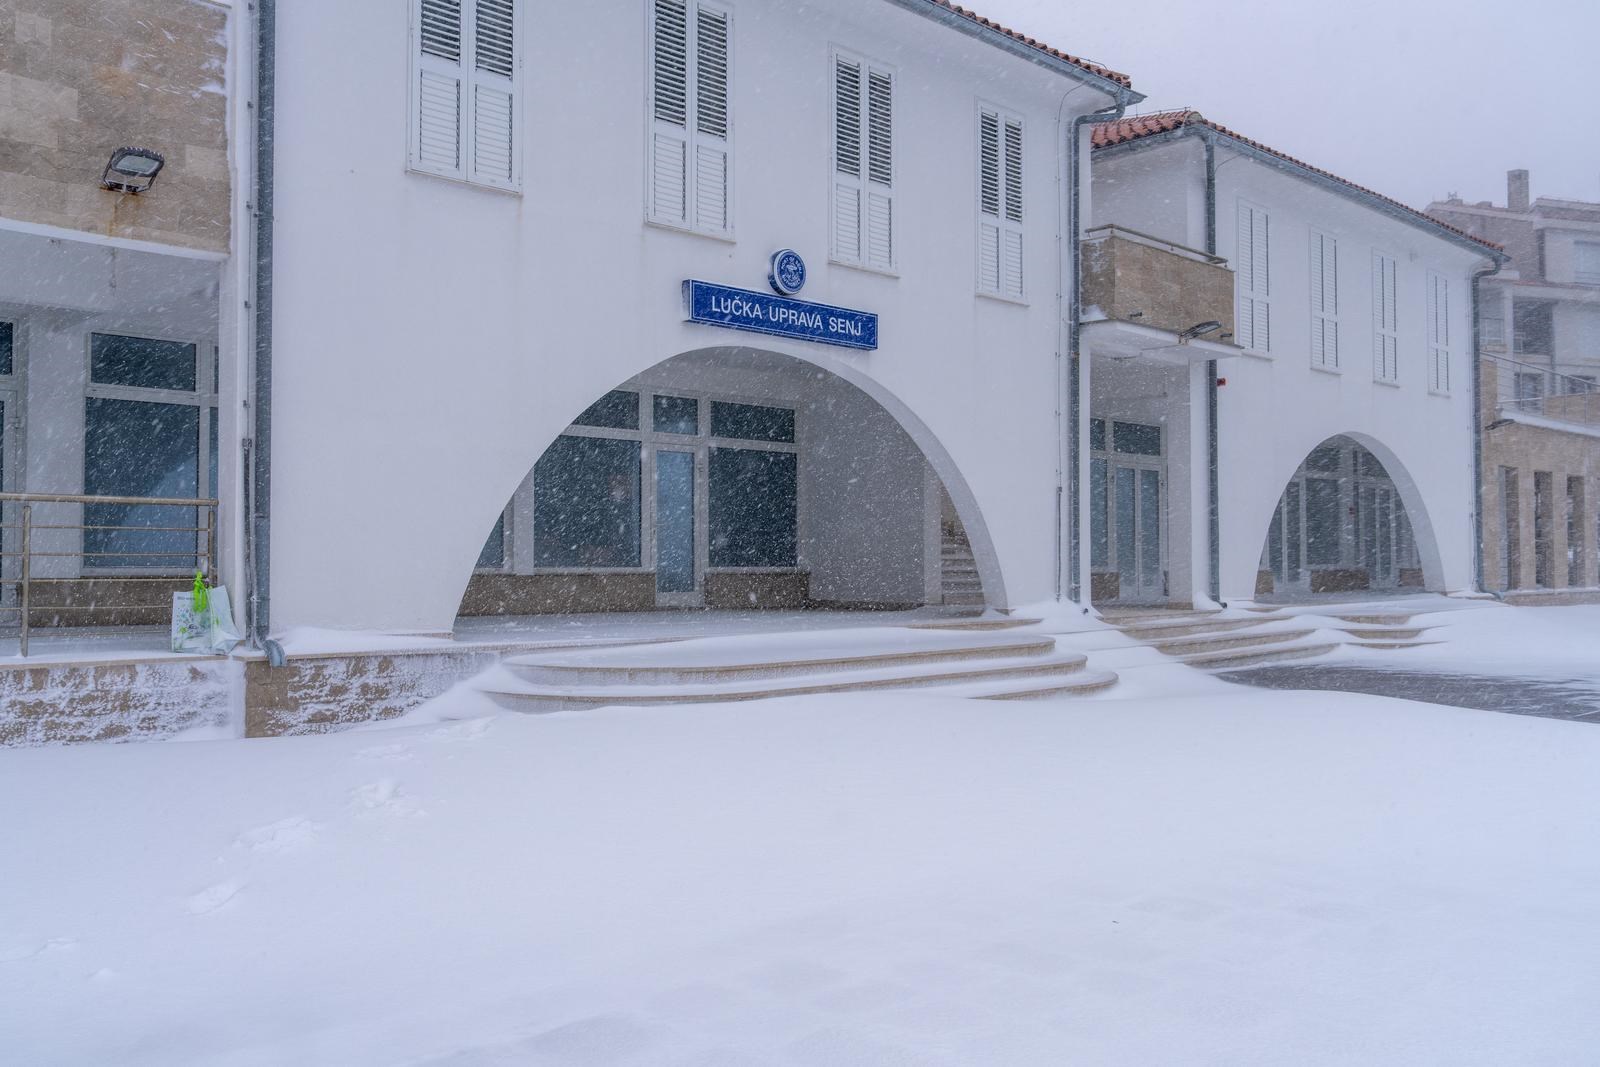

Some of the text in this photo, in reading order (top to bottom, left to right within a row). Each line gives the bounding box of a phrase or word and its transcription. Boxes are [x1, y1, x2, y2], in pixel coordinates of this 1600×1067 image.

[712, 296, 862, 336] LUČKA UPRAVA SENJ
